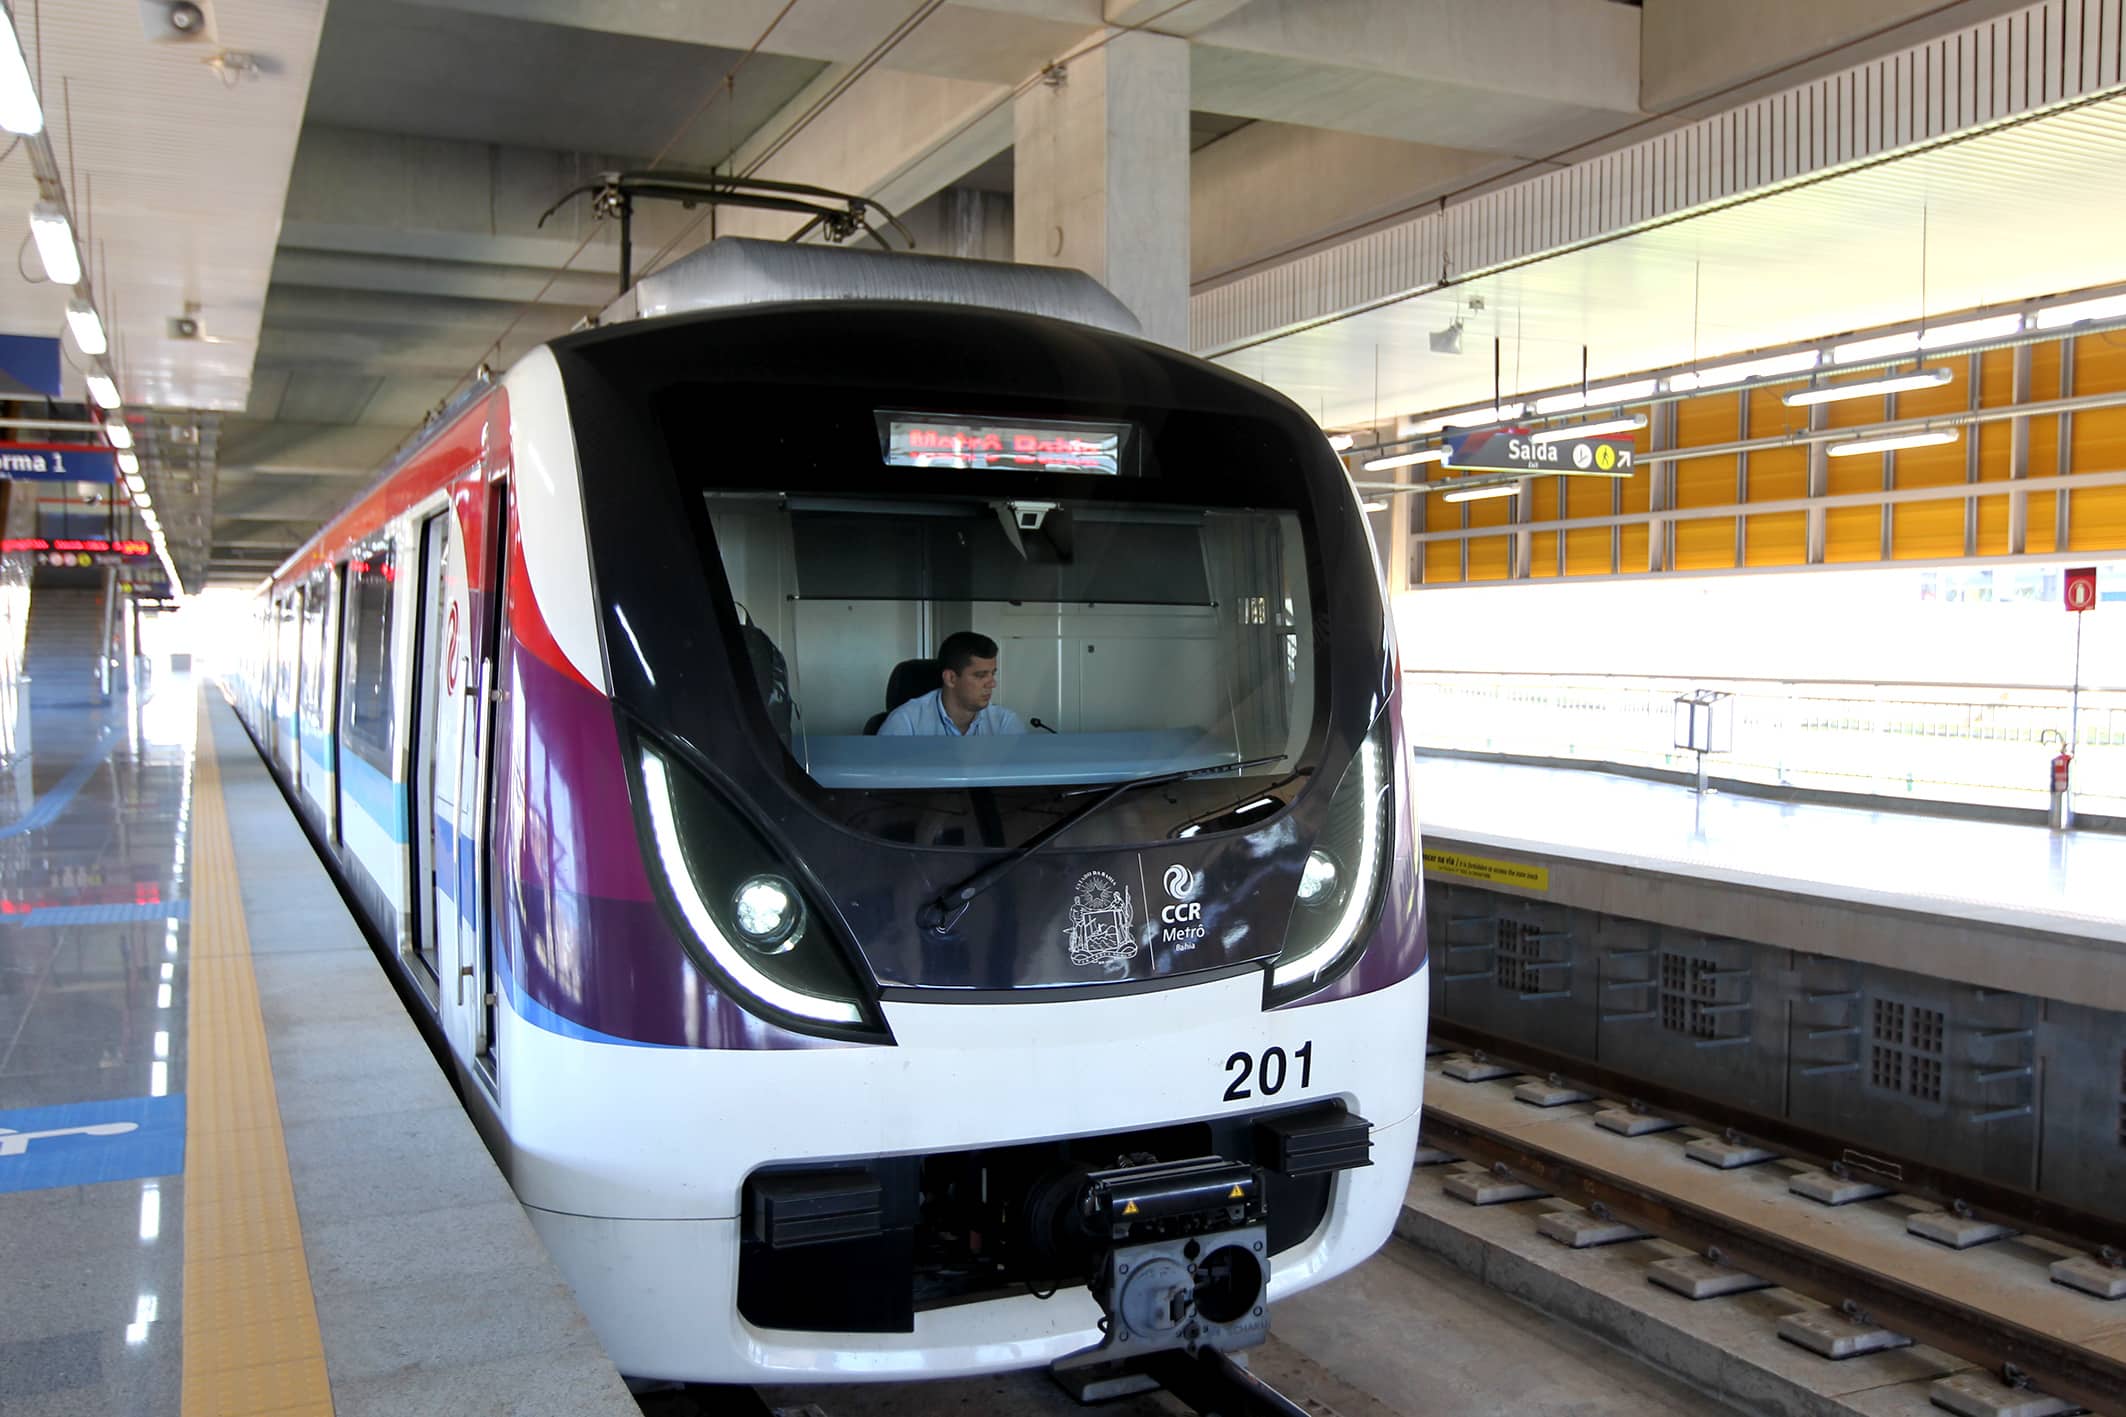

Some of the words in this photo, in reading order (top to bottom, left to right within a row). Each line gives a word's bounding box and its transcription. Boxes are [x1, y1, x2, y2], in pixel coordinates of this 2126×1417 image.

[51, 451, 67, 473] 1
[1161, 902, 1201, 924] CCR
[1162, 924, 1205, 943] Metrô
[1175, 942, 1196, 952] Bahia
[1223, 1040, 1313, 1102] 201
